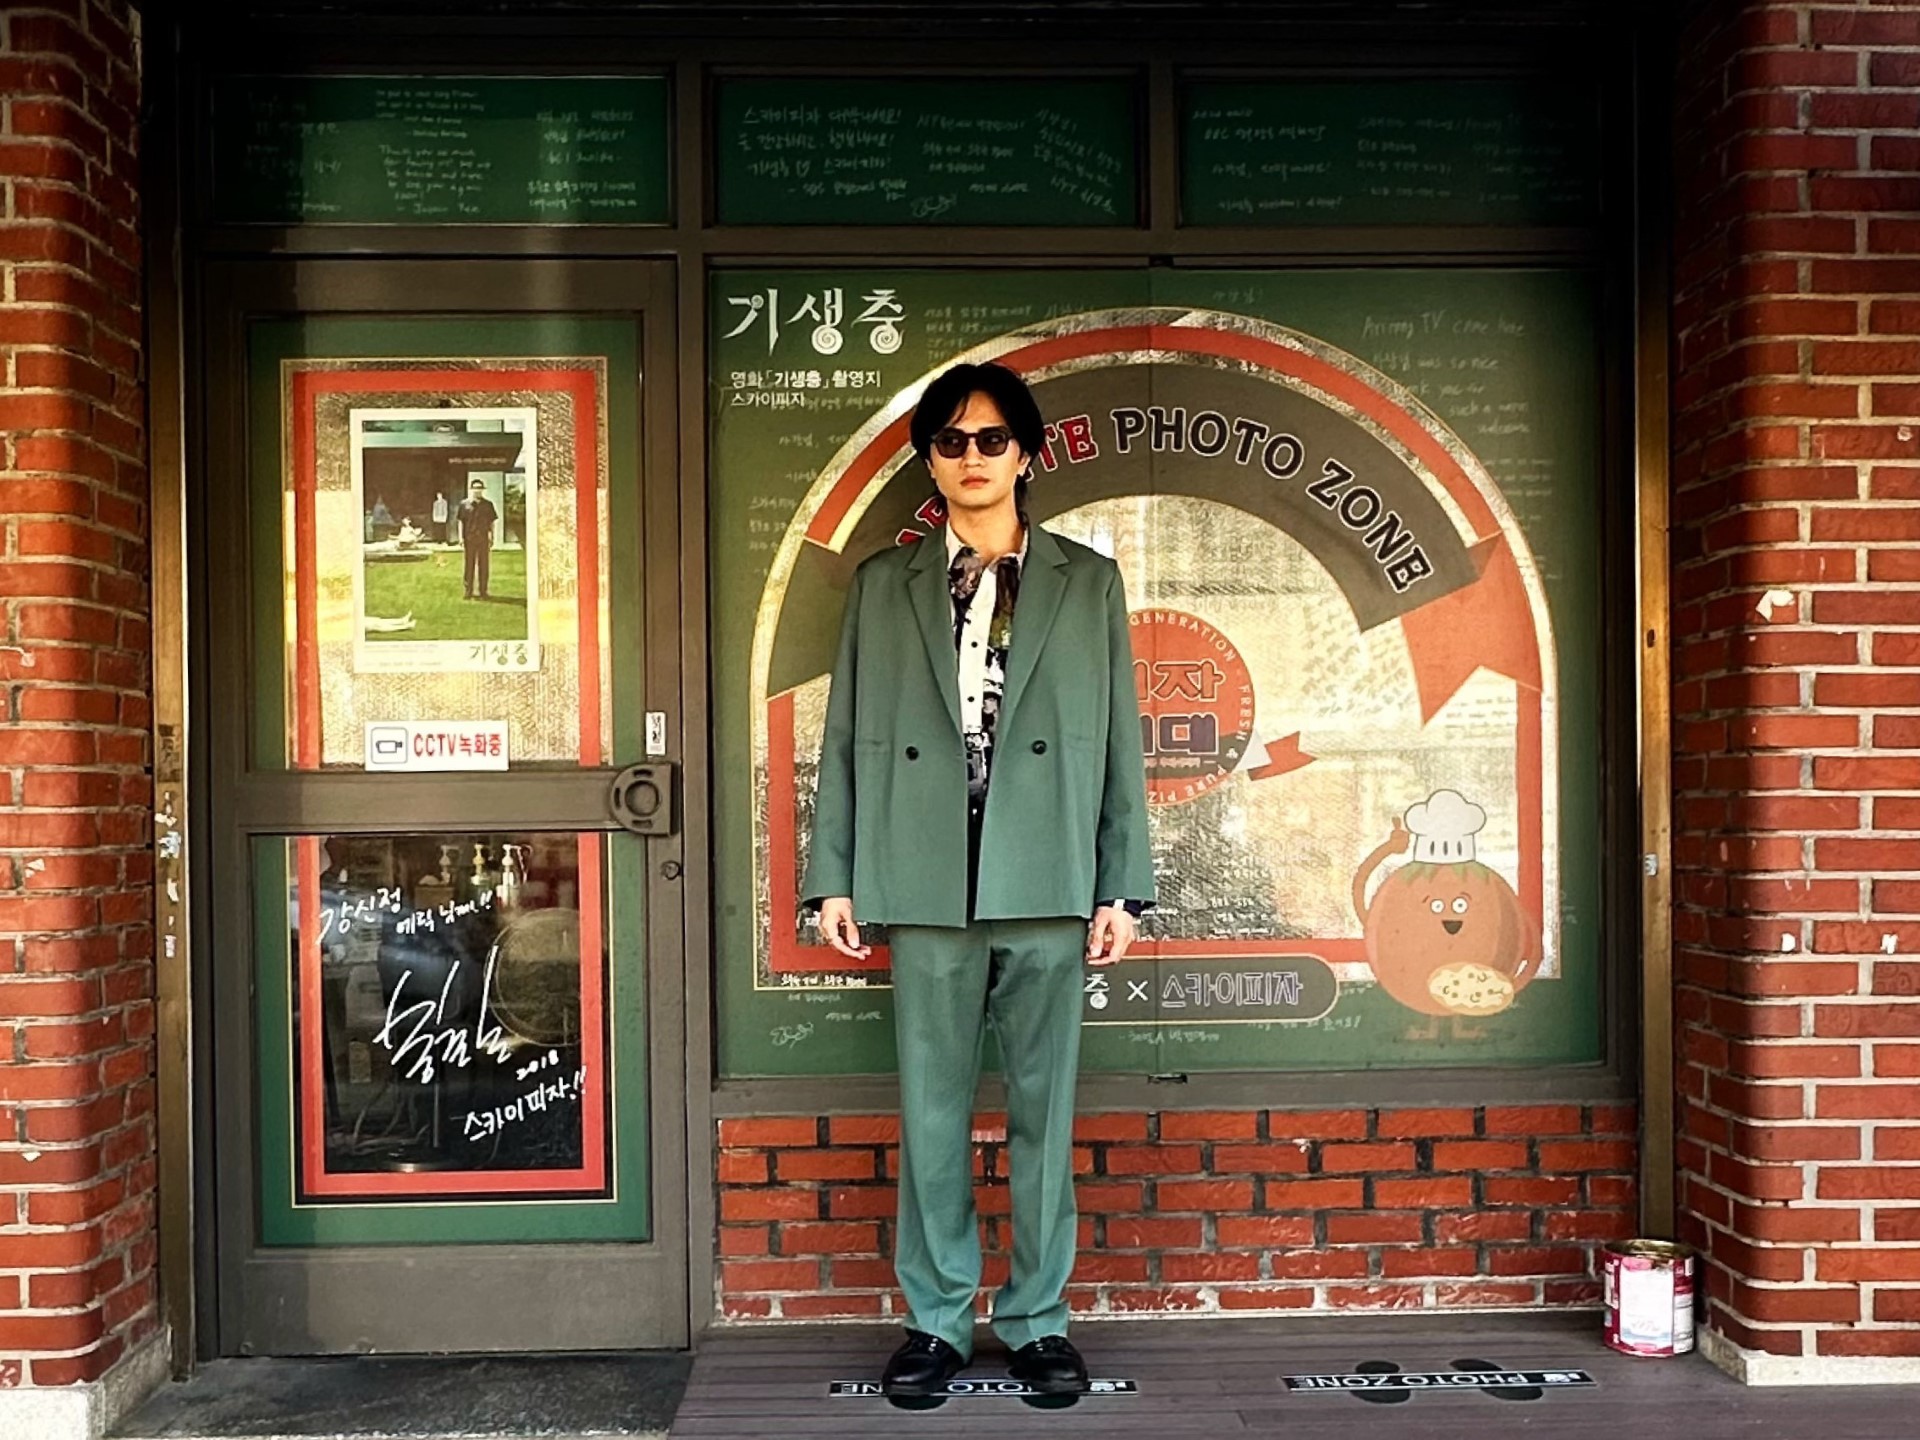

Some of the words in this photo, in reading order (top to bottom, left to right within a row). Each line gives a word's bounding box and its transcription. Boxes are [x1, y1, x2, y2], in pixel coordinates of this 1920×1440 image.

[742, 104, 820, 126] 스카이피자
[721, 288, 907, 356] 기생충
[1420, 310, 1446, 333] TV
[730, 371, 763, 389] 영화
[730, 391, 805, 408] 스카이피자
[1111, 407, 1304, 480] PHOTO
[1306, 458, 1434, 593] ZONE
[1129, 612, 1236, 662] GENERATION
[1236, 684, 1252, 741] FRESH
[413, 732, 502, 757] CCTV녹화중
[1186, 764, 1227, 797] PURE
[1147, 790, 1177, 803] PIZ
[1162, 971, 1304, 1008] 스카이피자
[840, 1383, 882, 1394] NE
[947, 1382, 1032, 1393] OTO
[1293, 1376, 1392, 1388] ZONE
[1403, 1373, 1528, 1385] PHOTO
